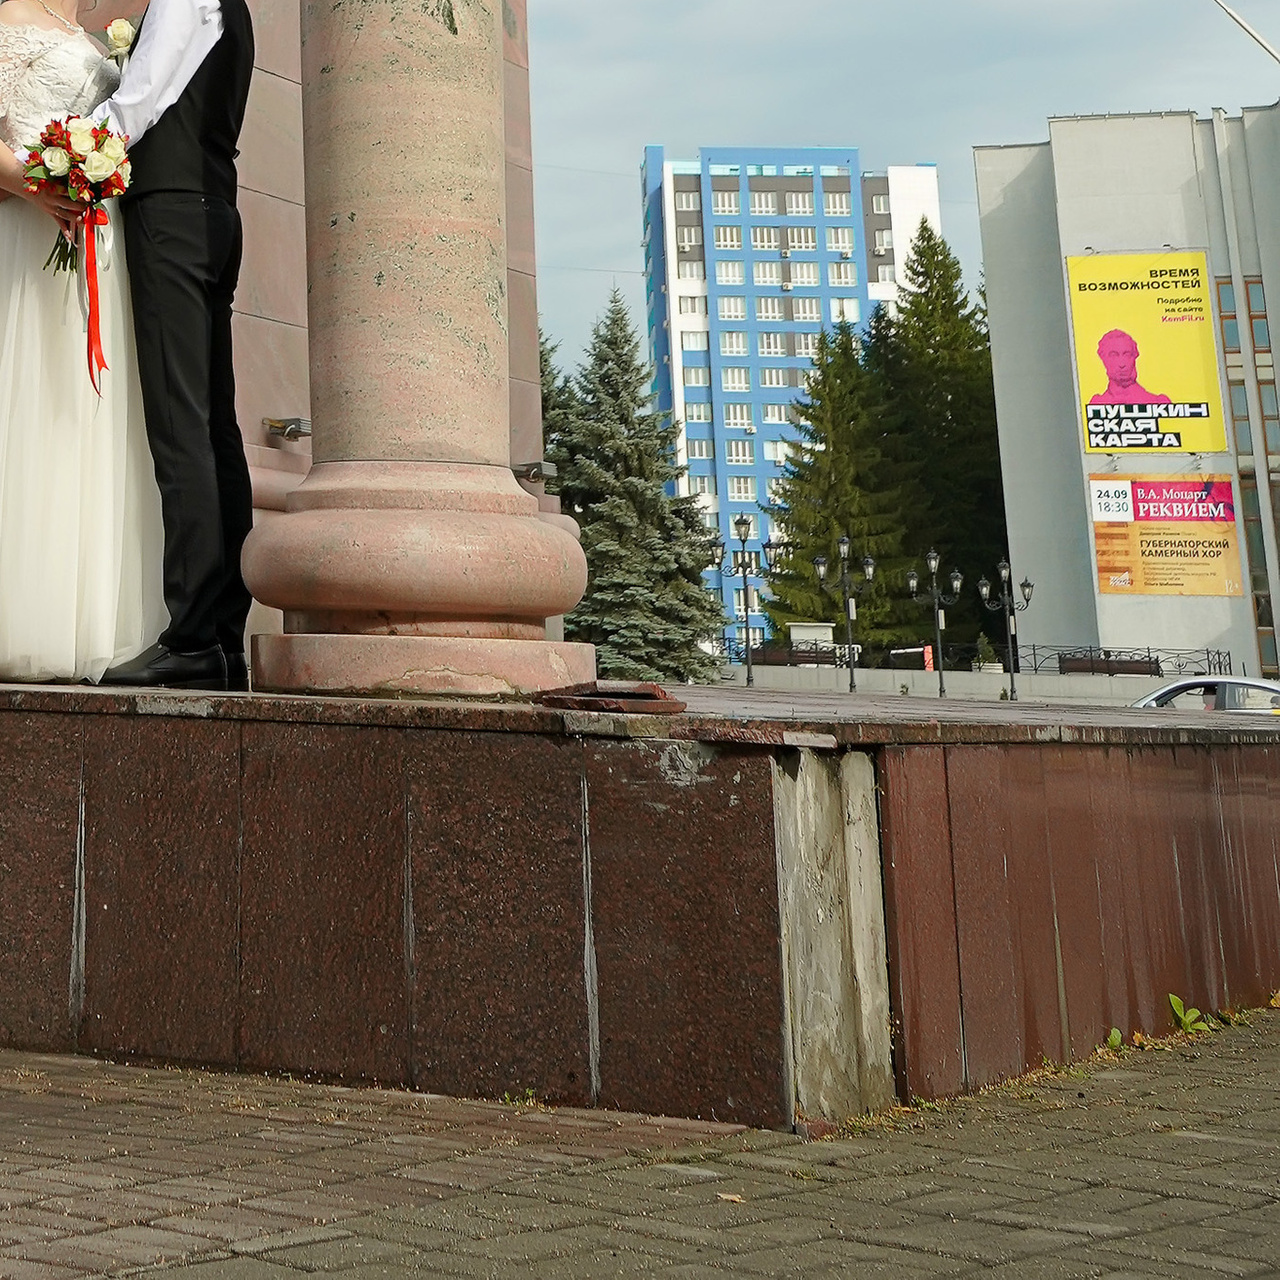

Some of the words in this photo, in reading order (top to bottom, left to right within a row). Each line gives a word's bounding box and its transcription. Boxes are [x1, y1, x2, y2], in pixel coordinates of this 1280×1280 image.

[1149, 268, 1200, 278] ВРЕМЯ
[1078, 277, 1201, 292] ВОЗМОЖНОСТЕЙ
[1156, 296, 1203, 305] Подробно
[1087, 403, 1208, 418] ПУШКИН
[1088, 418, 1157, 432] СКАЯ
[1090, 432, 1180, 447] КАРТА
[1096, 490, 1128, 499] 24.09
[1162, 488, 1208, 502] Моцарт
[1097, 502, 1129, 513] 18:30
[1138, 502, 1226, 518] РЕКВИЕМ
[1140, 539, 1230, 549] ГУБЕРНАТОРСКИЙ
[1141, 548, 1200, 558] КАМЕРНЫЙ
[1201, 549, 1222, 558] ХОР
